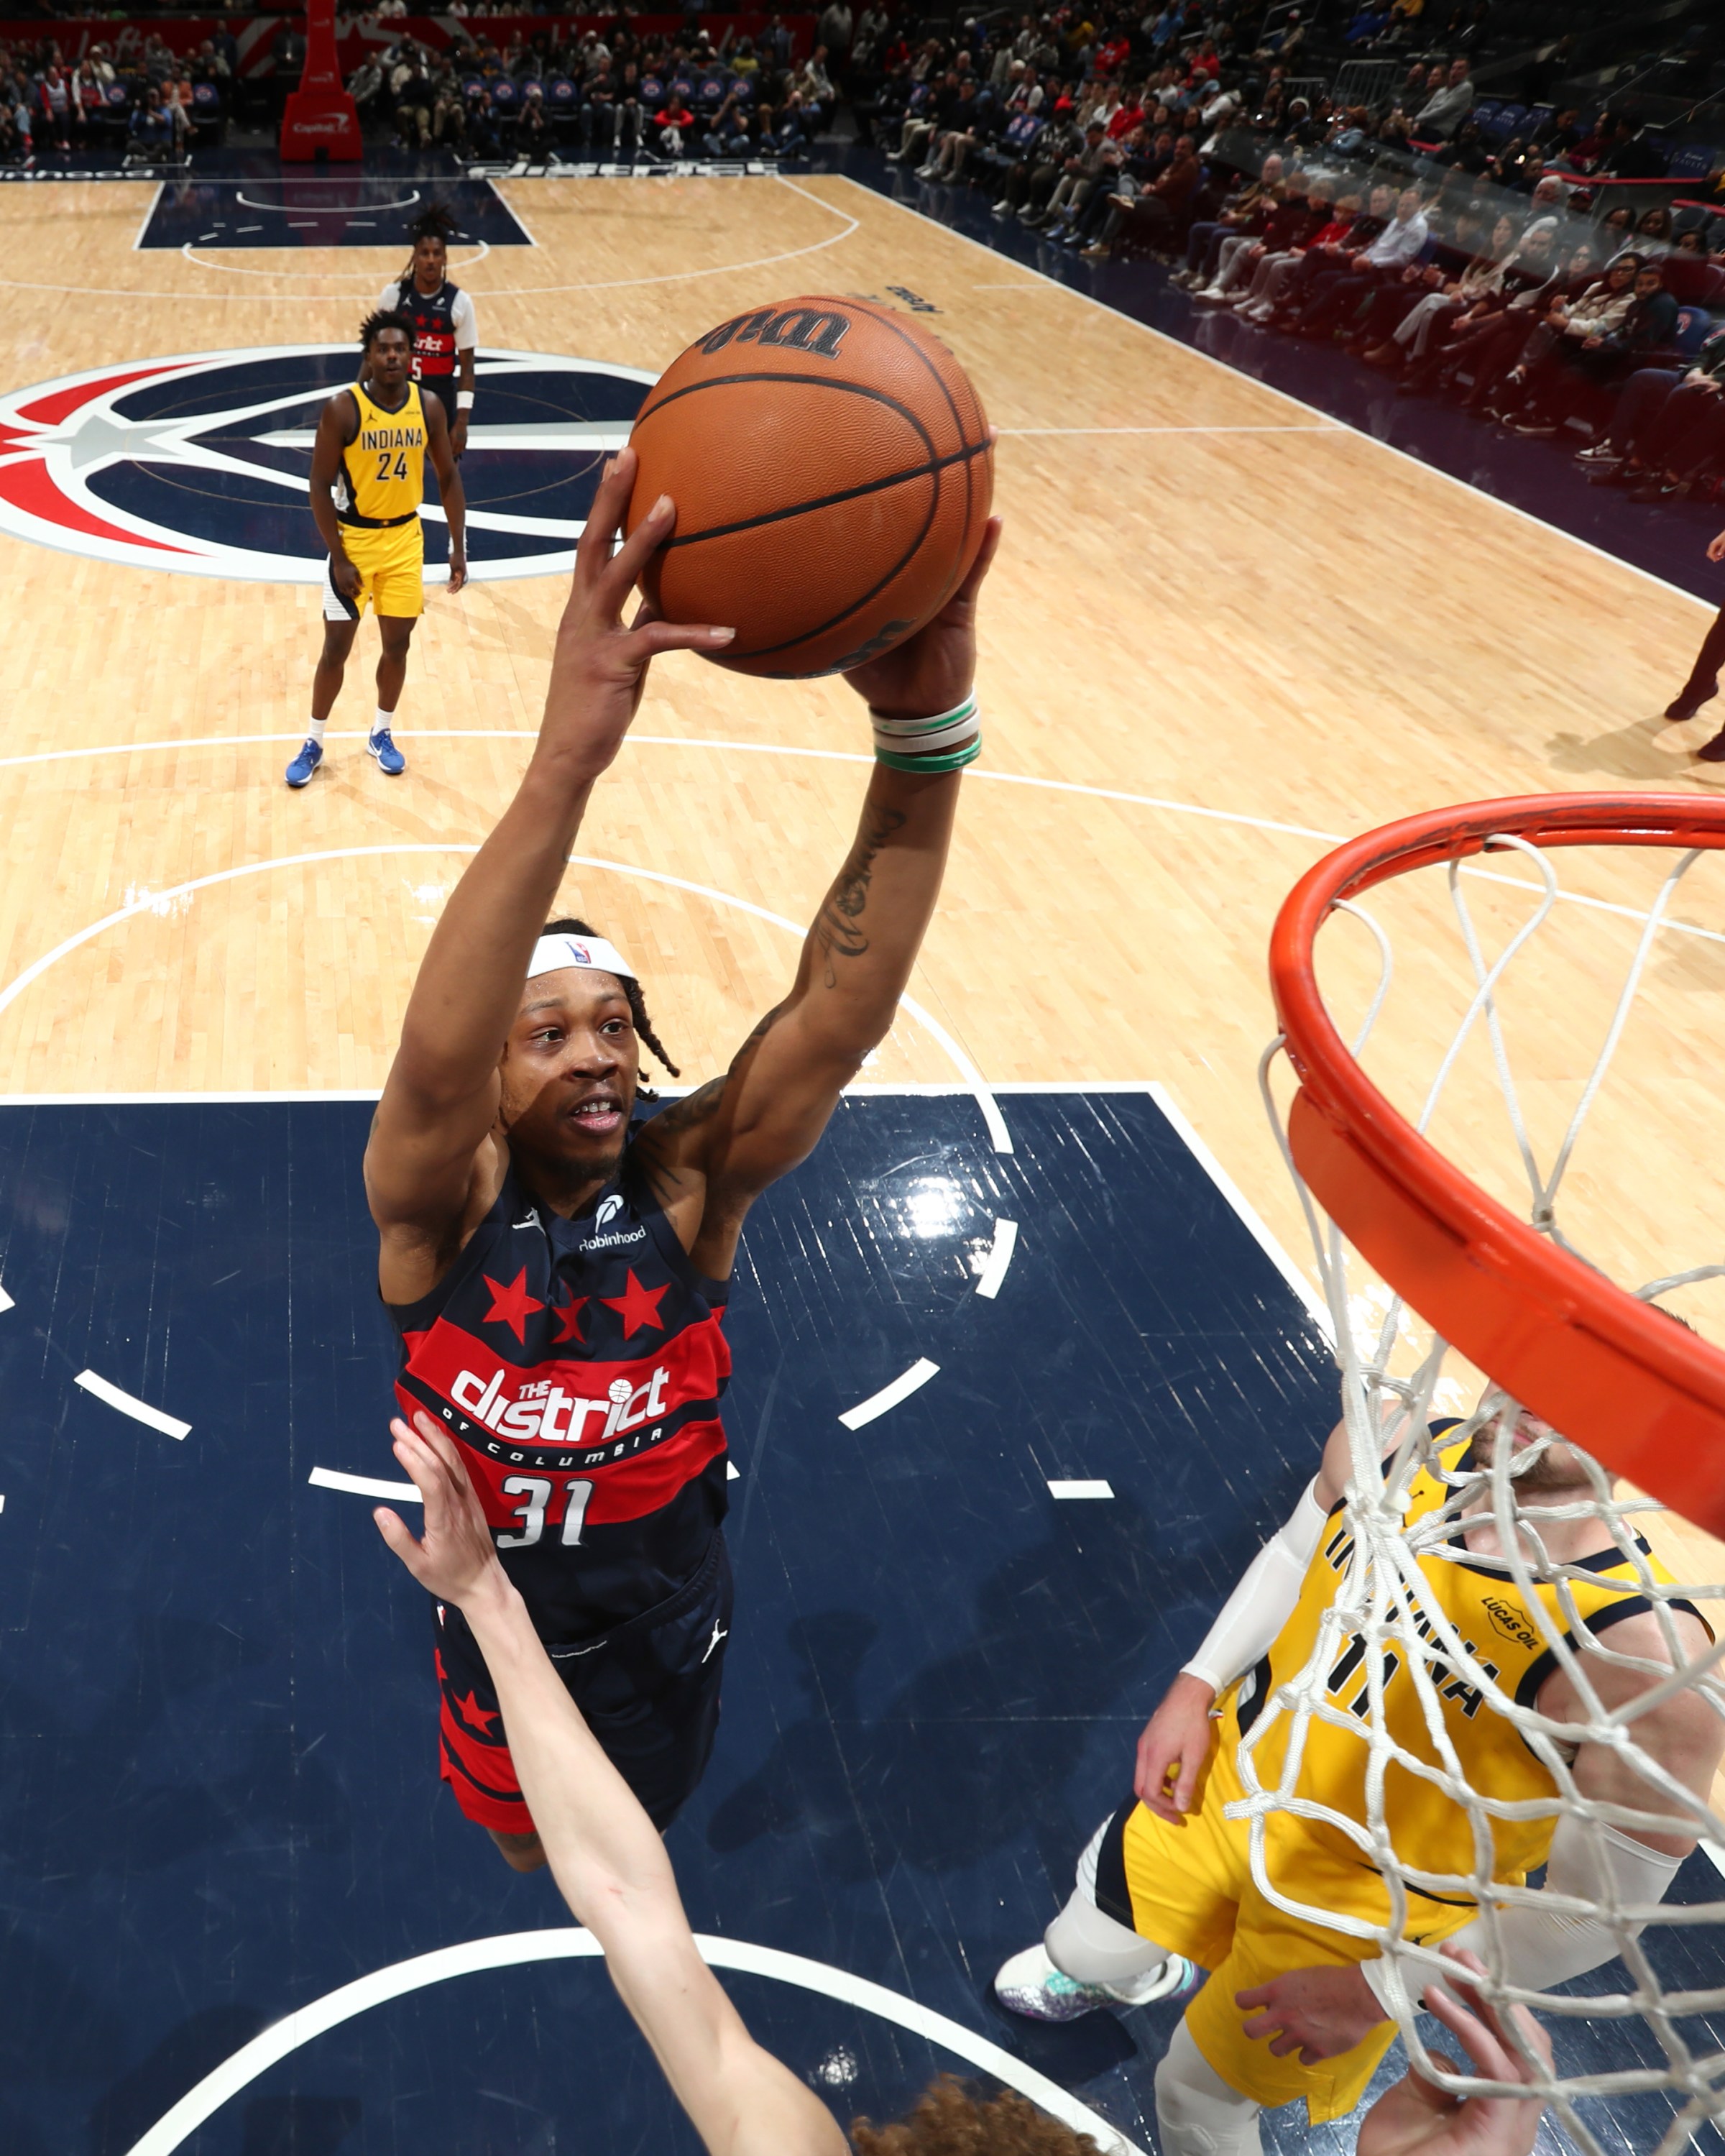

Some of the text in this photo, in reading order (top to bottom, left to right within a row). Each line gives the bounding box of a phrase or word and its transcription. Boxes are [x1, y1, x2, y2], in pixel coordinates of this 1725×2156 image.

[695, 308, 851, 359] Wil
[362, 428, 423, 451] INDIANA
[376, 451, 408, 481] 24
[579, 1225, 646, 1252] Robinhood
[451, 1366, 670, 1441] district
[519, 1380, 551, 1400] THE
[442, 1407, 662, 1467] OF COLUMBIA
[496, 1474, 594, 1549] 31
[1481, 1596, 1539, 1651] LUCAS OIL
[1327, 1631, 1399, 1719] 11
